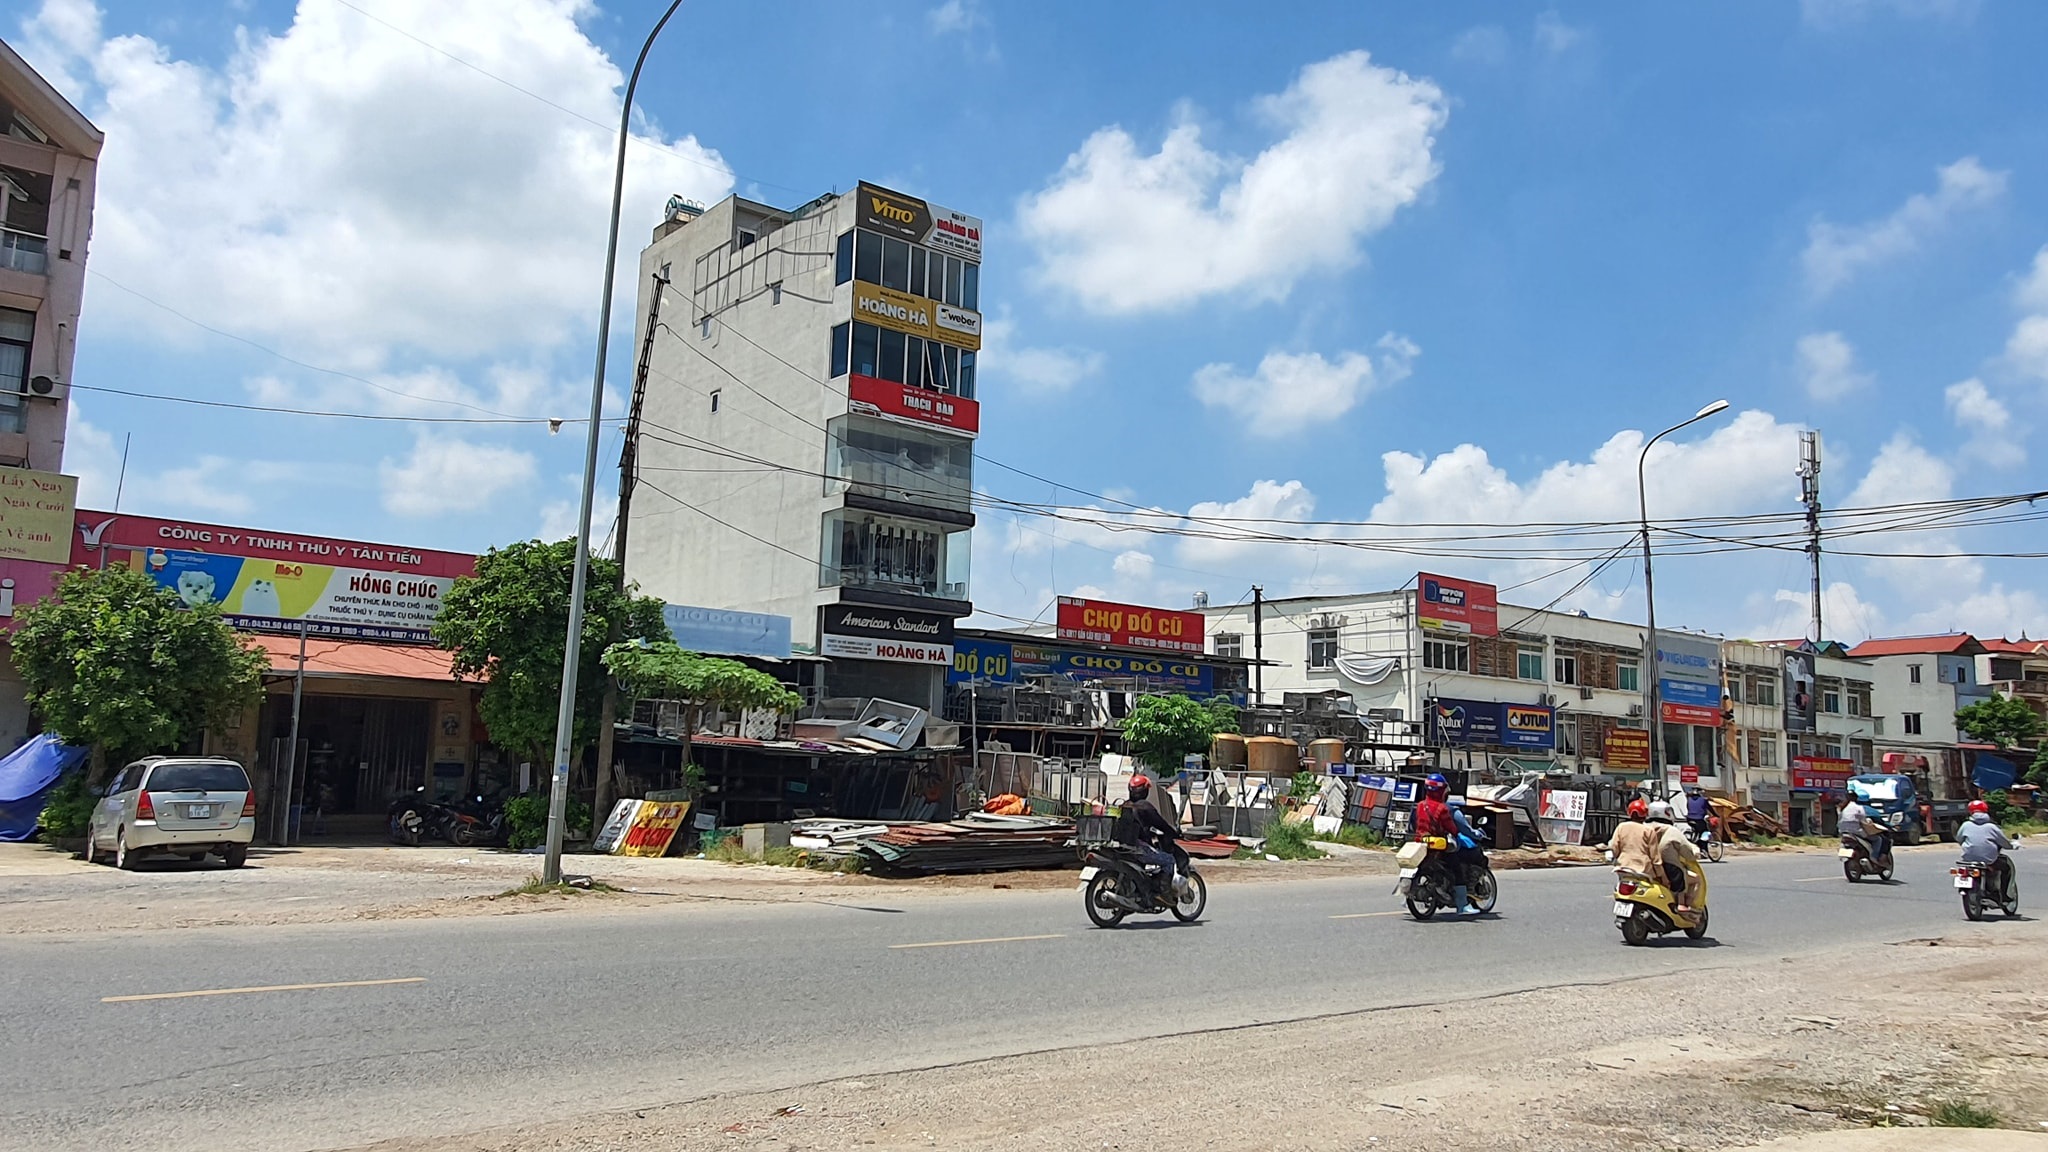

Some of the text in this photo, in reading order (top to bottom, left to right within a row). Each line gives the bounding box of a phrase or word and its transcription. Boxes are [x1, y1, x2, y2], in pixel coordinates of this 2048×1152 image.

[871, 197, 914, 223] VITTO
[858, 295, 907, 321] HOÀNG
[908, 308, 929, 327] HÀ
[948, 311, 976, 327] weber
[158, 526, 212, 542] CÔNG
[217, 533, 241, 545] TY
[246, 536, 293, 551] TNHH
[297, 541, 331, 555] THÚ
[335, 546, 346, 556] Y
[351, 546, 384, 561] TÂN
[397, 579, 438, 599] CHÚC
[840, 612, 939, 634] American Standard
[1083, 608, 1123, 632] CHỢ
[1158, 616, 1182, 636] CŨ
[876, 643, 925, 661] HOÀNG
[928, 647, 947, 662] HÀ
[984, 653, 1007, 676] CŨ
[1070, 655, 1123, 671] CHỢ
[1170, 665, 1199, 678] CŨ
[1519, 713, 1549, 727] JOTUN
